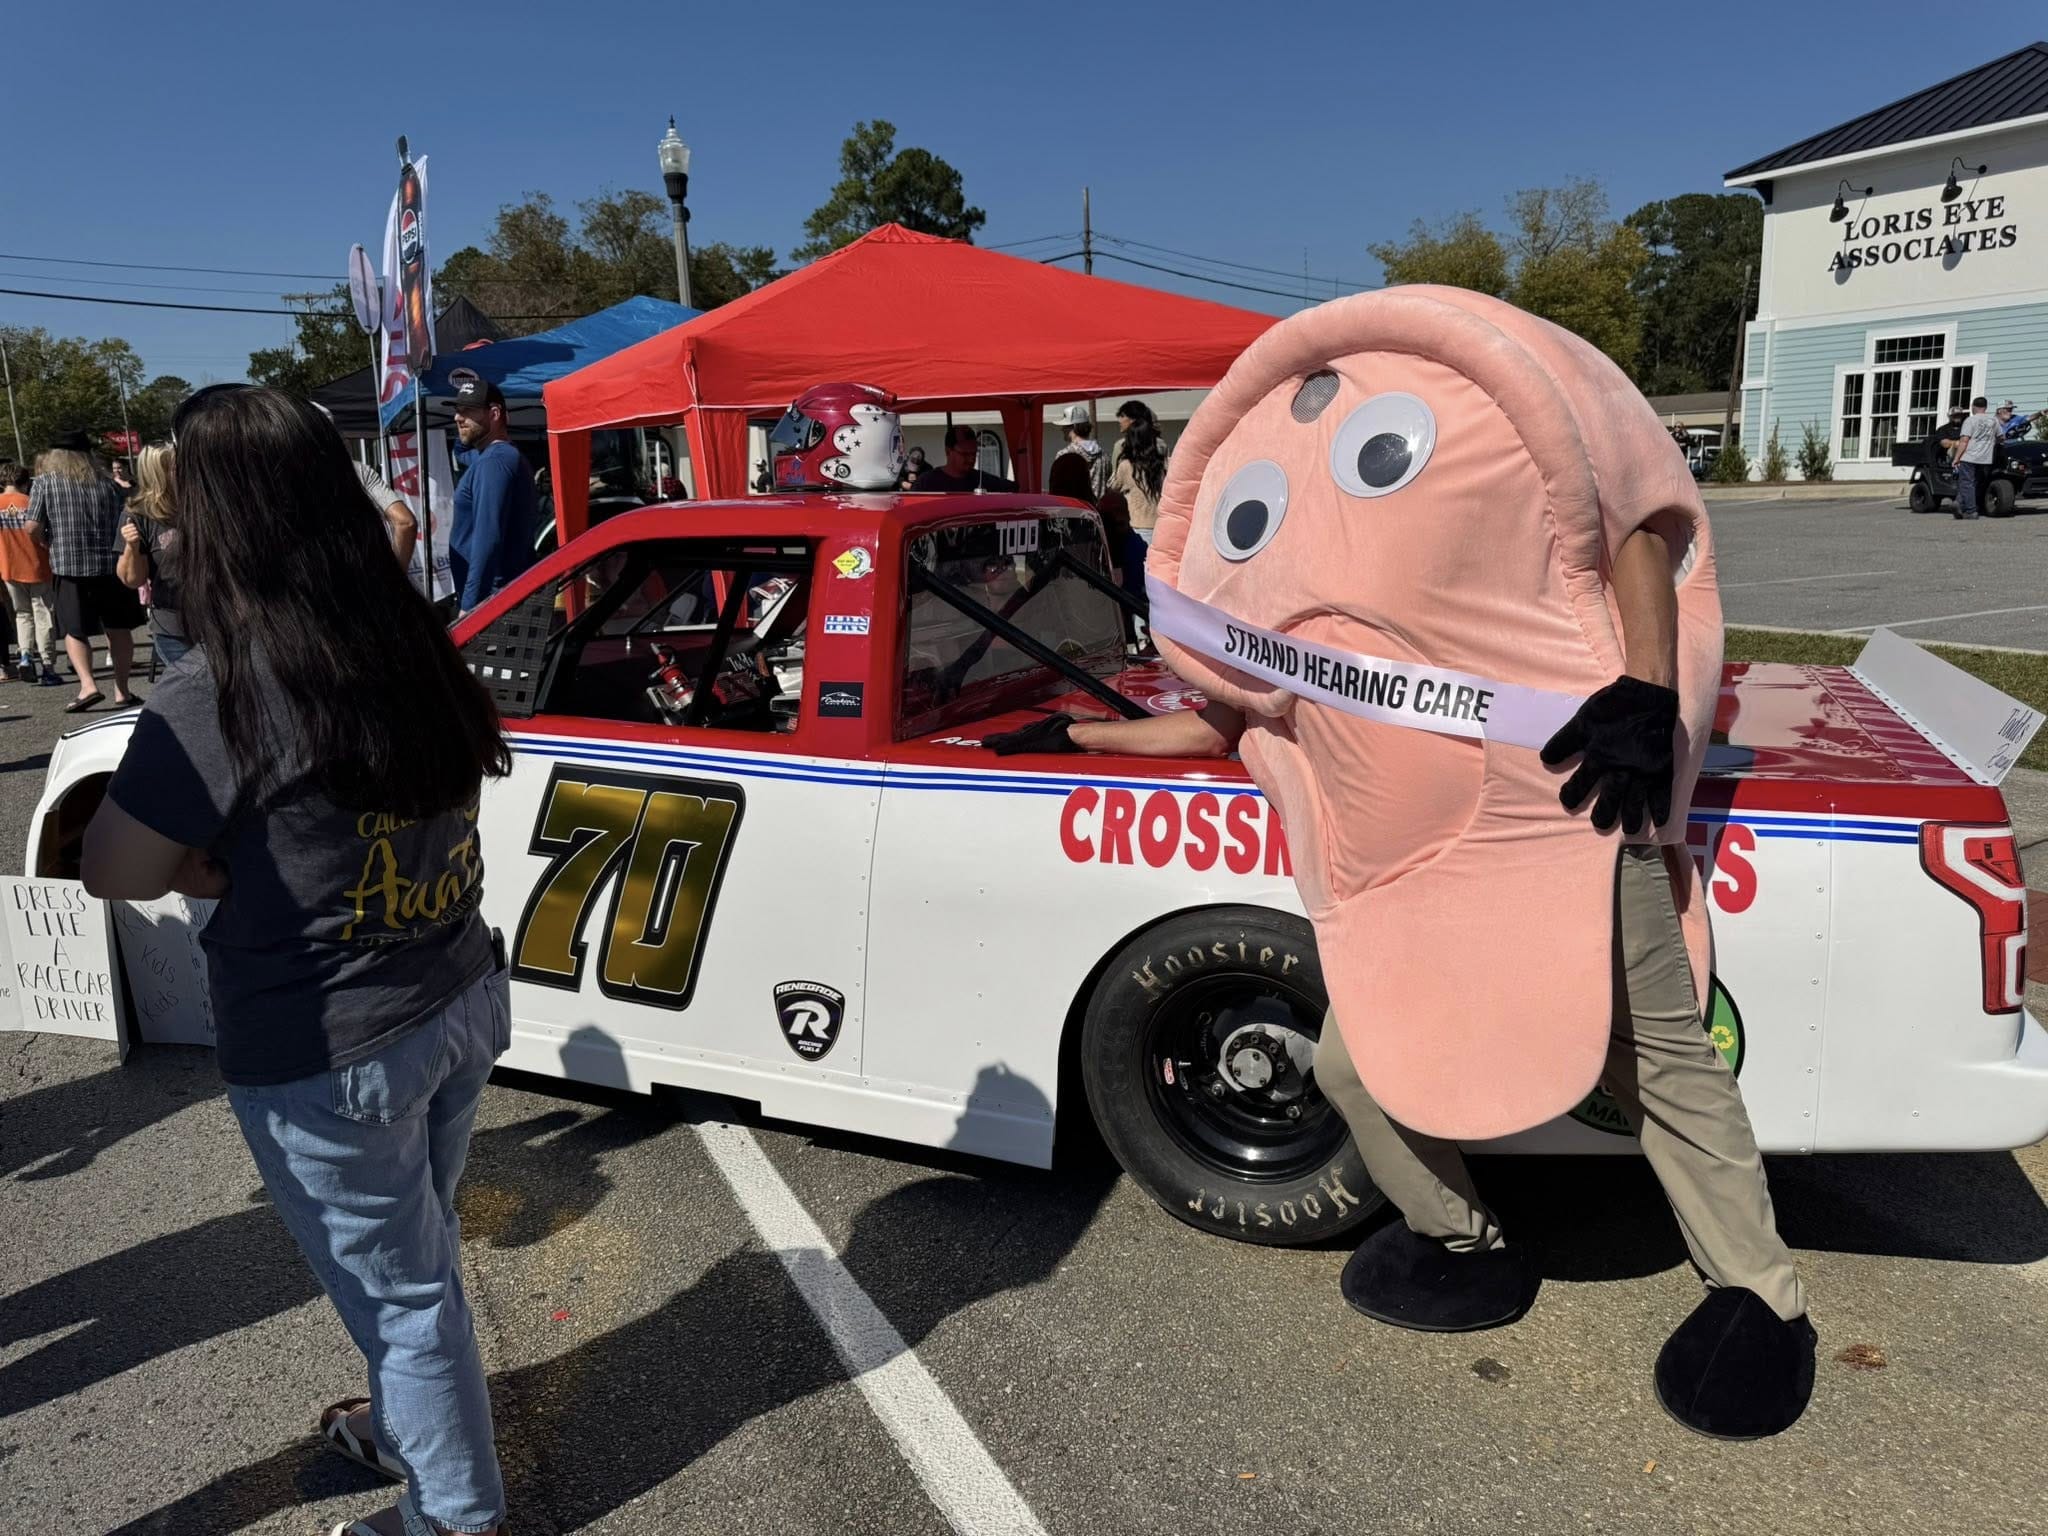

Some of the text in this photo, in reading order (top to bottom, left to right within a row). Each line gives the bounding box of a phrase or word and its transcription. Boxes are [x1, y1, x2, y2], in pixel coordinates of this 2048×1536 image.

[402, 227, 417, 244] PEPSI
[1843, 195, 2005, 242] LORIS EYE
[1828, 224, 2017, 272] ASSOCIATES
[1225, 623, 1495, 723] STRAND HEARING CARE
[13, 883, 86, 912] DRESS
[510, 762, 746, 1012] 70
[25, 910, 86, 937] LIKE
[54, 937, 72, 966] A
[141, 943, 176, 984] Kids
[1131, 929, 1299, 1003] Hoosier
[17, 962, 111, 996] RACECAR
[776, 982, 842, 1001] RENEGADE
[34, 995, 110, 1022] DRIVER
[139, 990, 180, 1023] Kids
[783, 1000, 831, 1040] R
[1188, 1166, 1359, 1233] Hoosier
